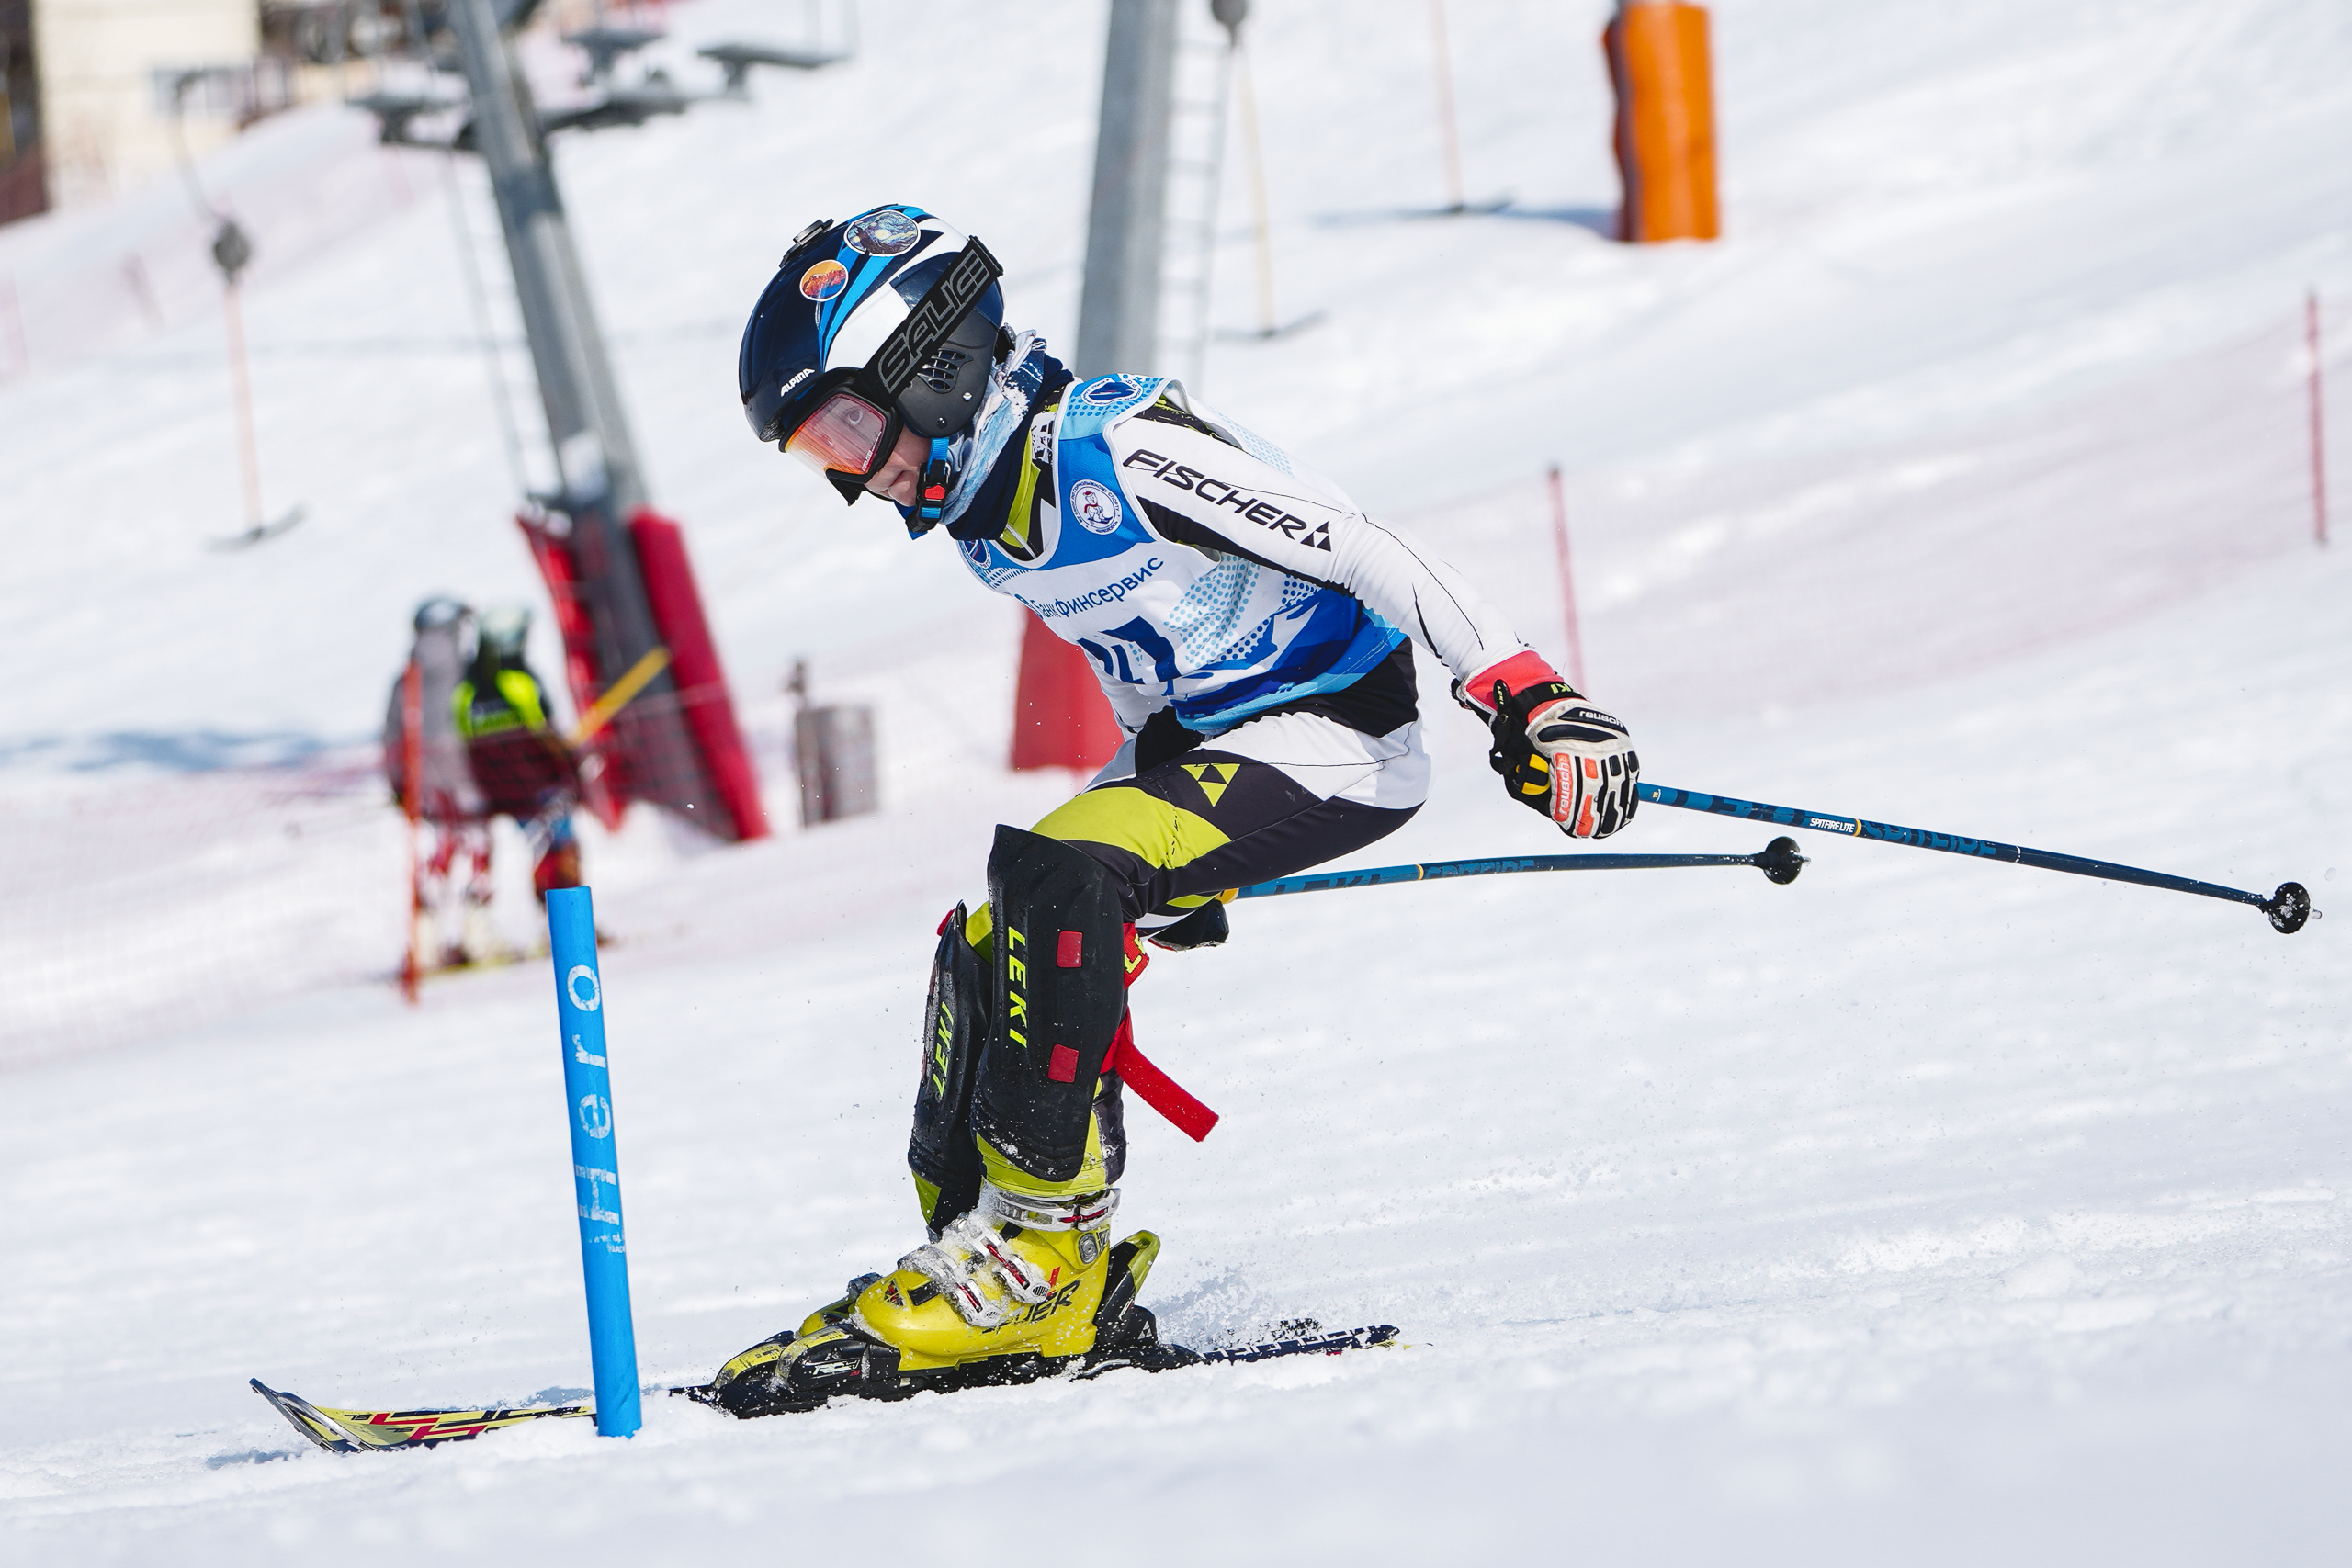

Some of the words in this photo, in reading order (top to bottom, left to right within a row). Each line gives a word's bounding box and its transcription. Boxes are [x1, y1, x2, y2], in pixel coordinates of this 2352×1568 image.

[780, 368, 815, 397] ALPINA
[1123, 448, 1307, 540] FISCHER
[1008, 926, 1027, 1049] LEKI
[567, 964, 620, 1226] Hero
